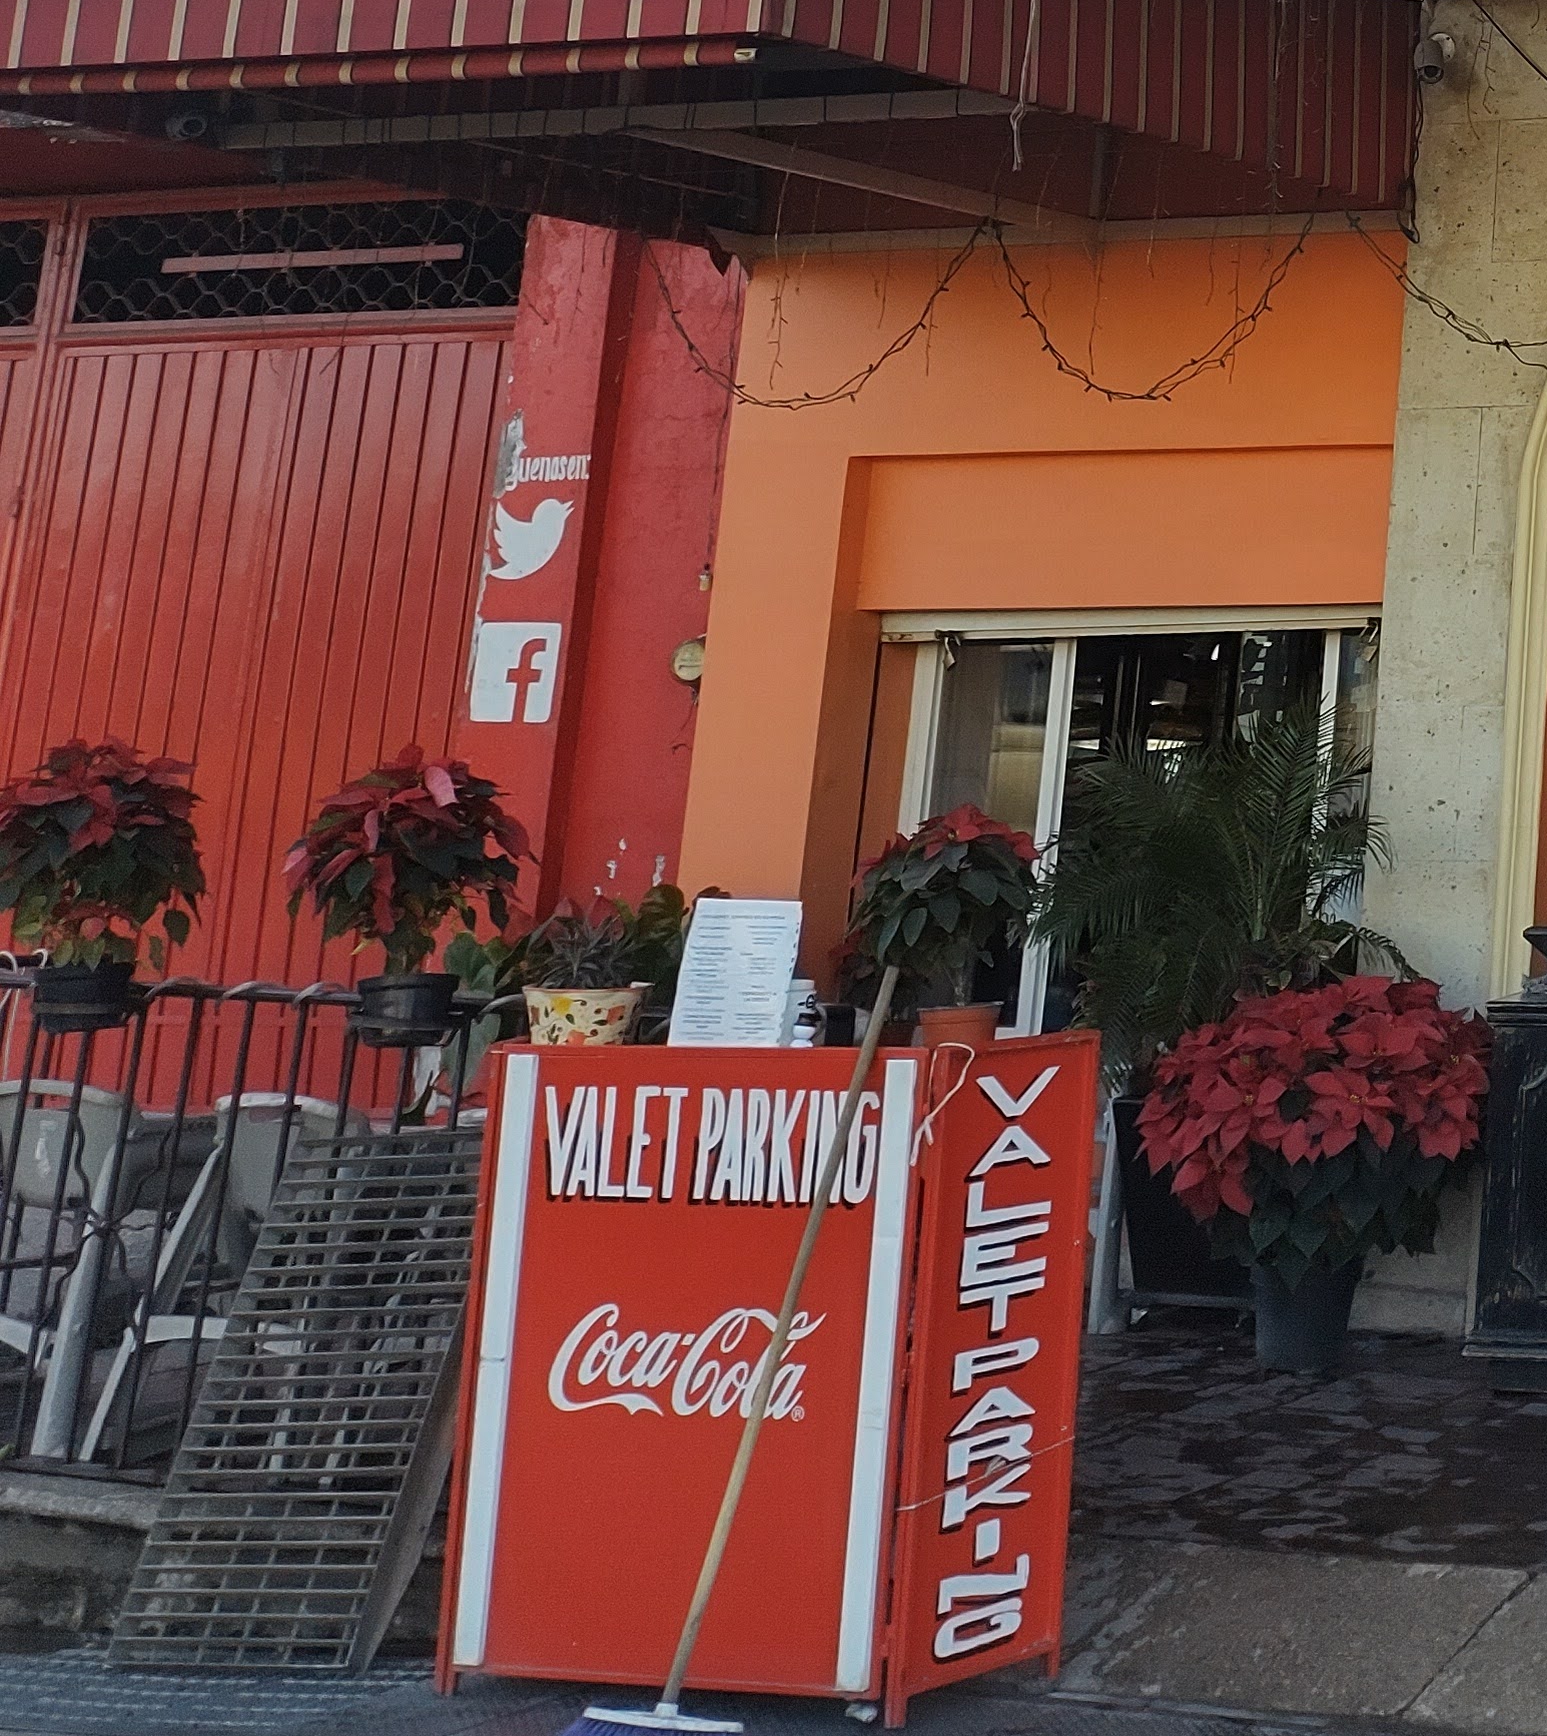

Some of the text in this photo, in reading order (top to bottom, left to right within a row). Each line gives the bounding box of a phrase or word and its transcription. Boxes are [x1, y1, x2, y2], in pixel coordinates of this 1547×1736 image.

[544, 1085, 882, 1205] VALET PARKING
[933, 1064, 1062, 1659] VALET PARKING
